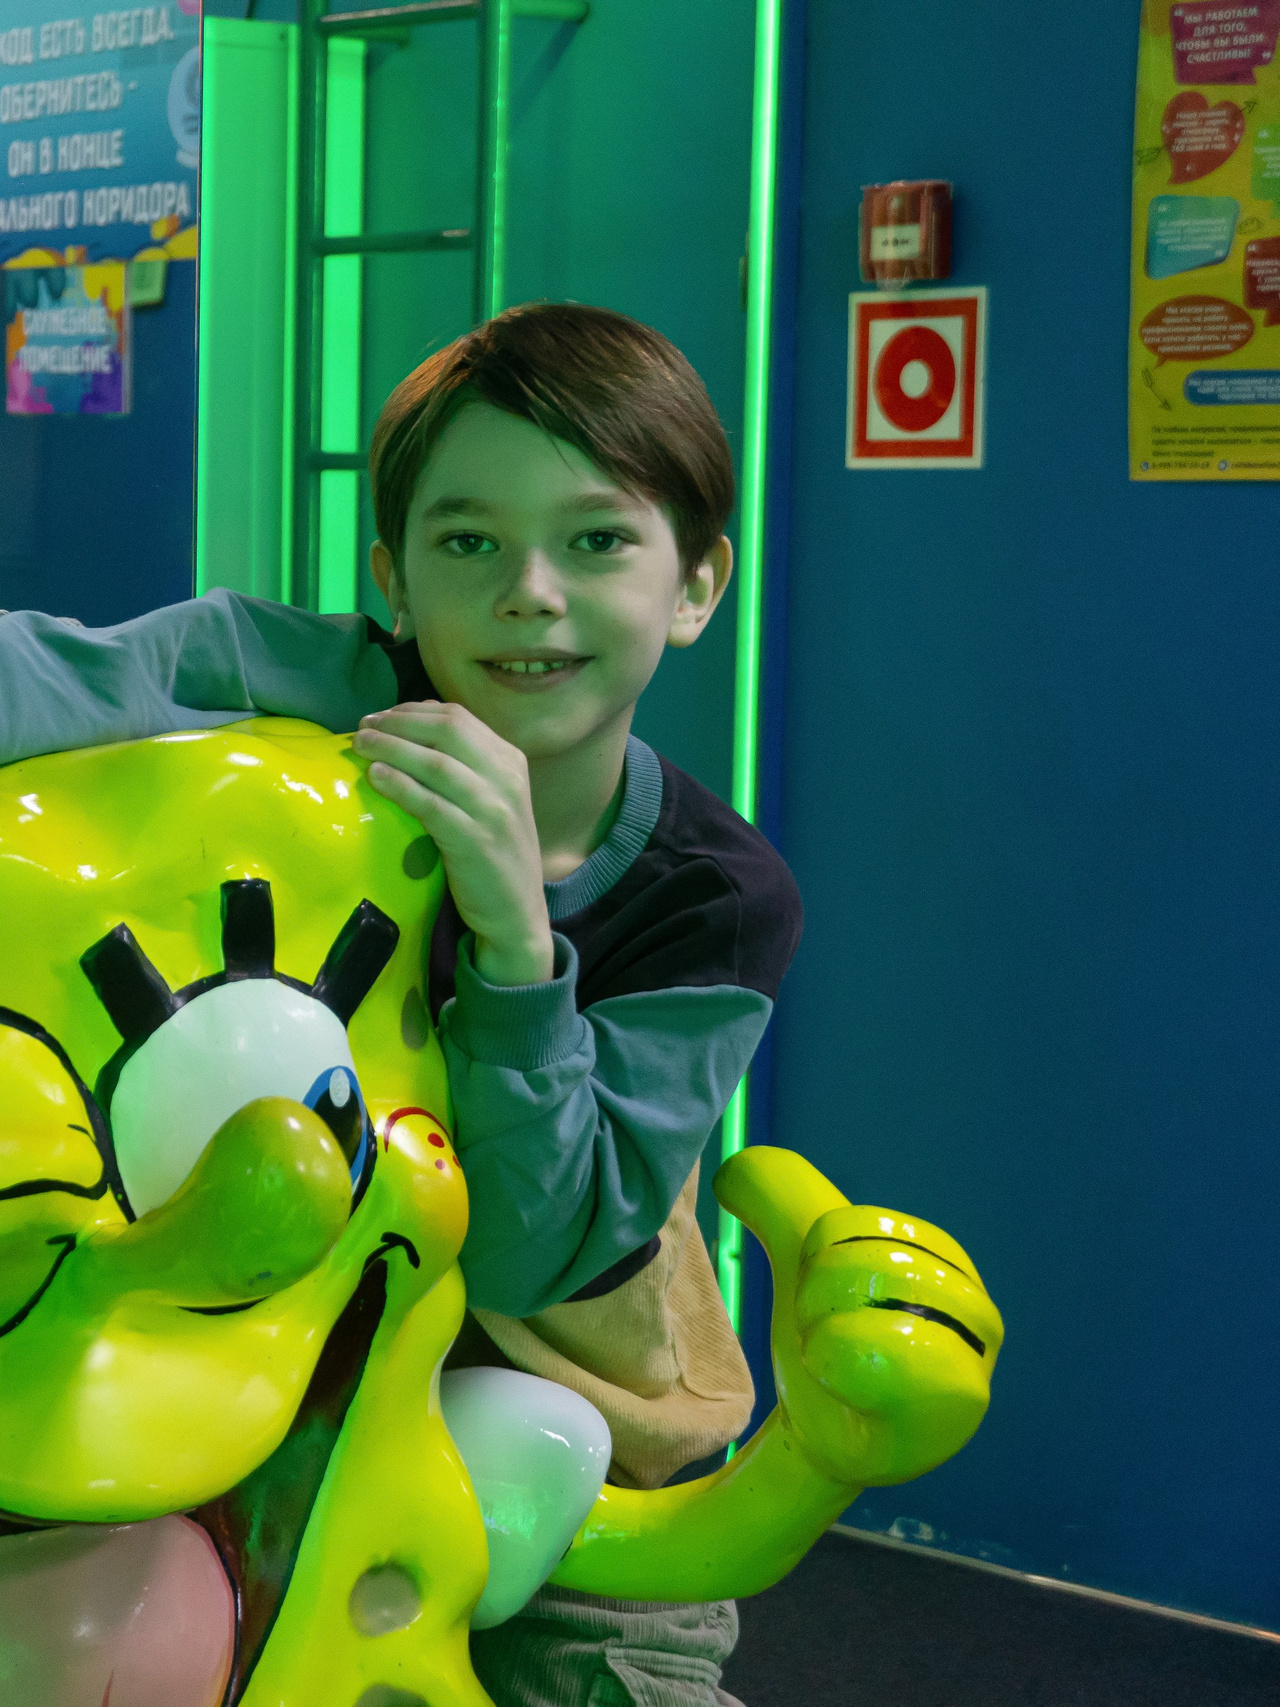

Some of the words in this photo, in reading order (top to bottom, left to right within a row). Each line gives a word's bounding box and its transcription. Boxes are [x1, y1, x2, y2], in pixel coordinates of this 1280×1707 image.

[1184, 14, 1203, 24] МЫ
[1205, 6, 1259, 22] РАБОТАЕМ
[38, 19, 86, 60] ЕСТЬ
[1175, 38, 1211, 51] ЧТОБЫ
[1213, 36, 1230, 49] ВЫ
[1232, 32, 1265, 46] БЫЛИ
[1192, 25, 1216, 38] ДЛЯ
[7, 138, 36, 177] ОН
[39, 136, 53, 175] В
[57, 129, 125, 172] КОНЦЕ
[82, 181, 191, 226] КОРИДОРА
